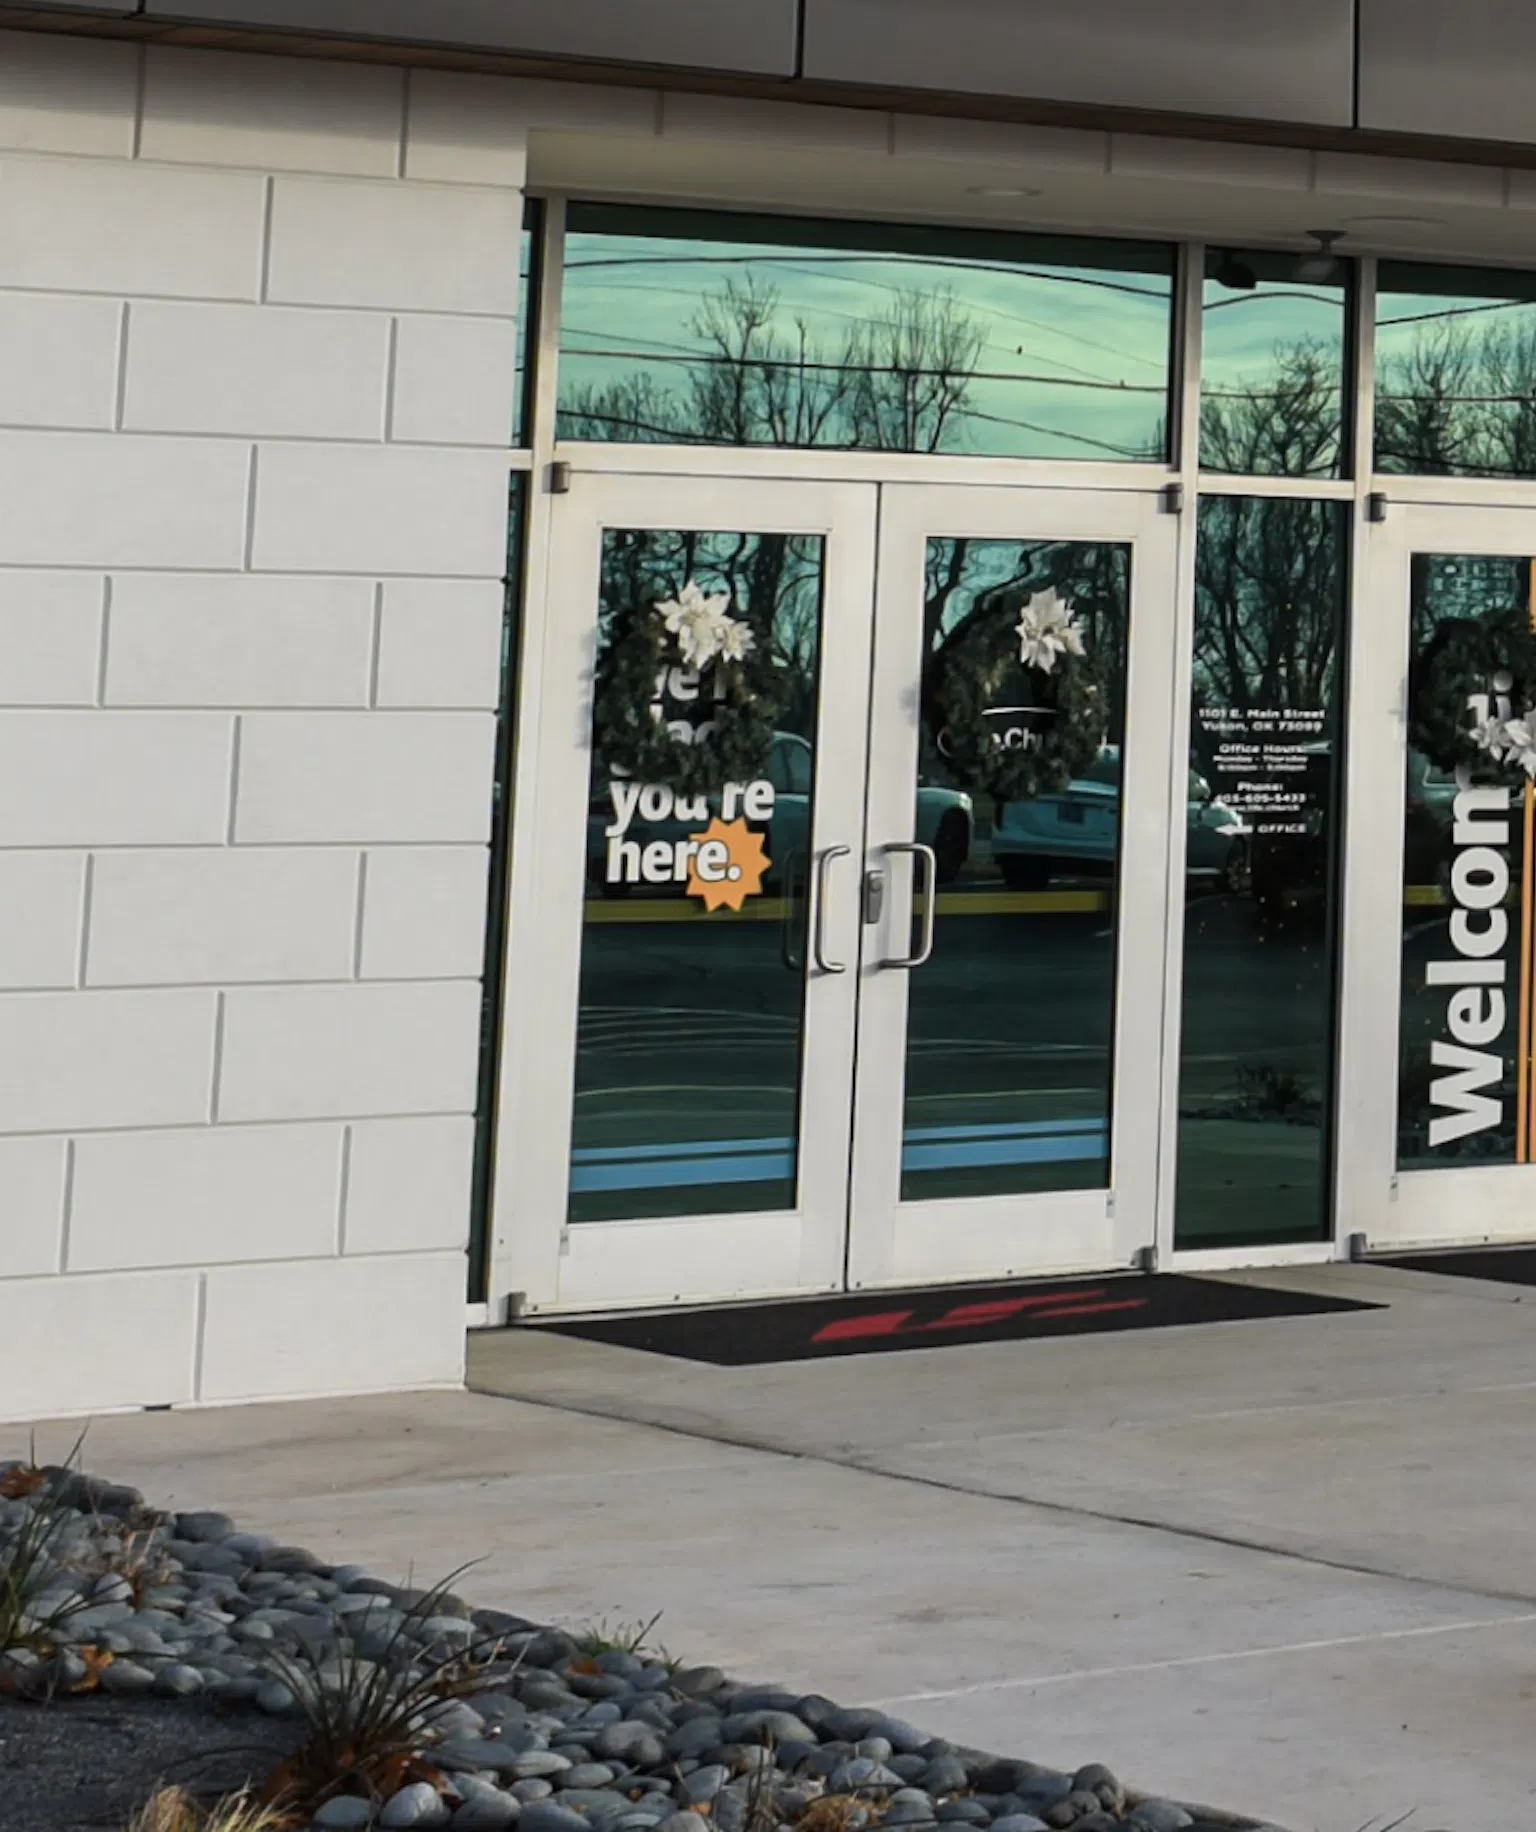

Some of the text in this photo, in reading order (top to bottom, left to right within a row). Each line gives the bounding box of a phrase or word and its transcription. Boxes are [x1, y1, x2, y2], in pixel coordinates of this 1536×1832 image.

[1247, 709, 1280, 718] Main
[1283, 709, 1326, 718] Street
[1202, 721, 1249, 732] Yukon,
[1252, 721, 1273, 731] OK
[1219, 743, 1261, 753] Office
[1237, 781, 1284, 791] Phone:
[605, 779, 776, 837] youre
[1257, 824, 1307, 833] OFFICE
[606, 835, 741, 883] here.
